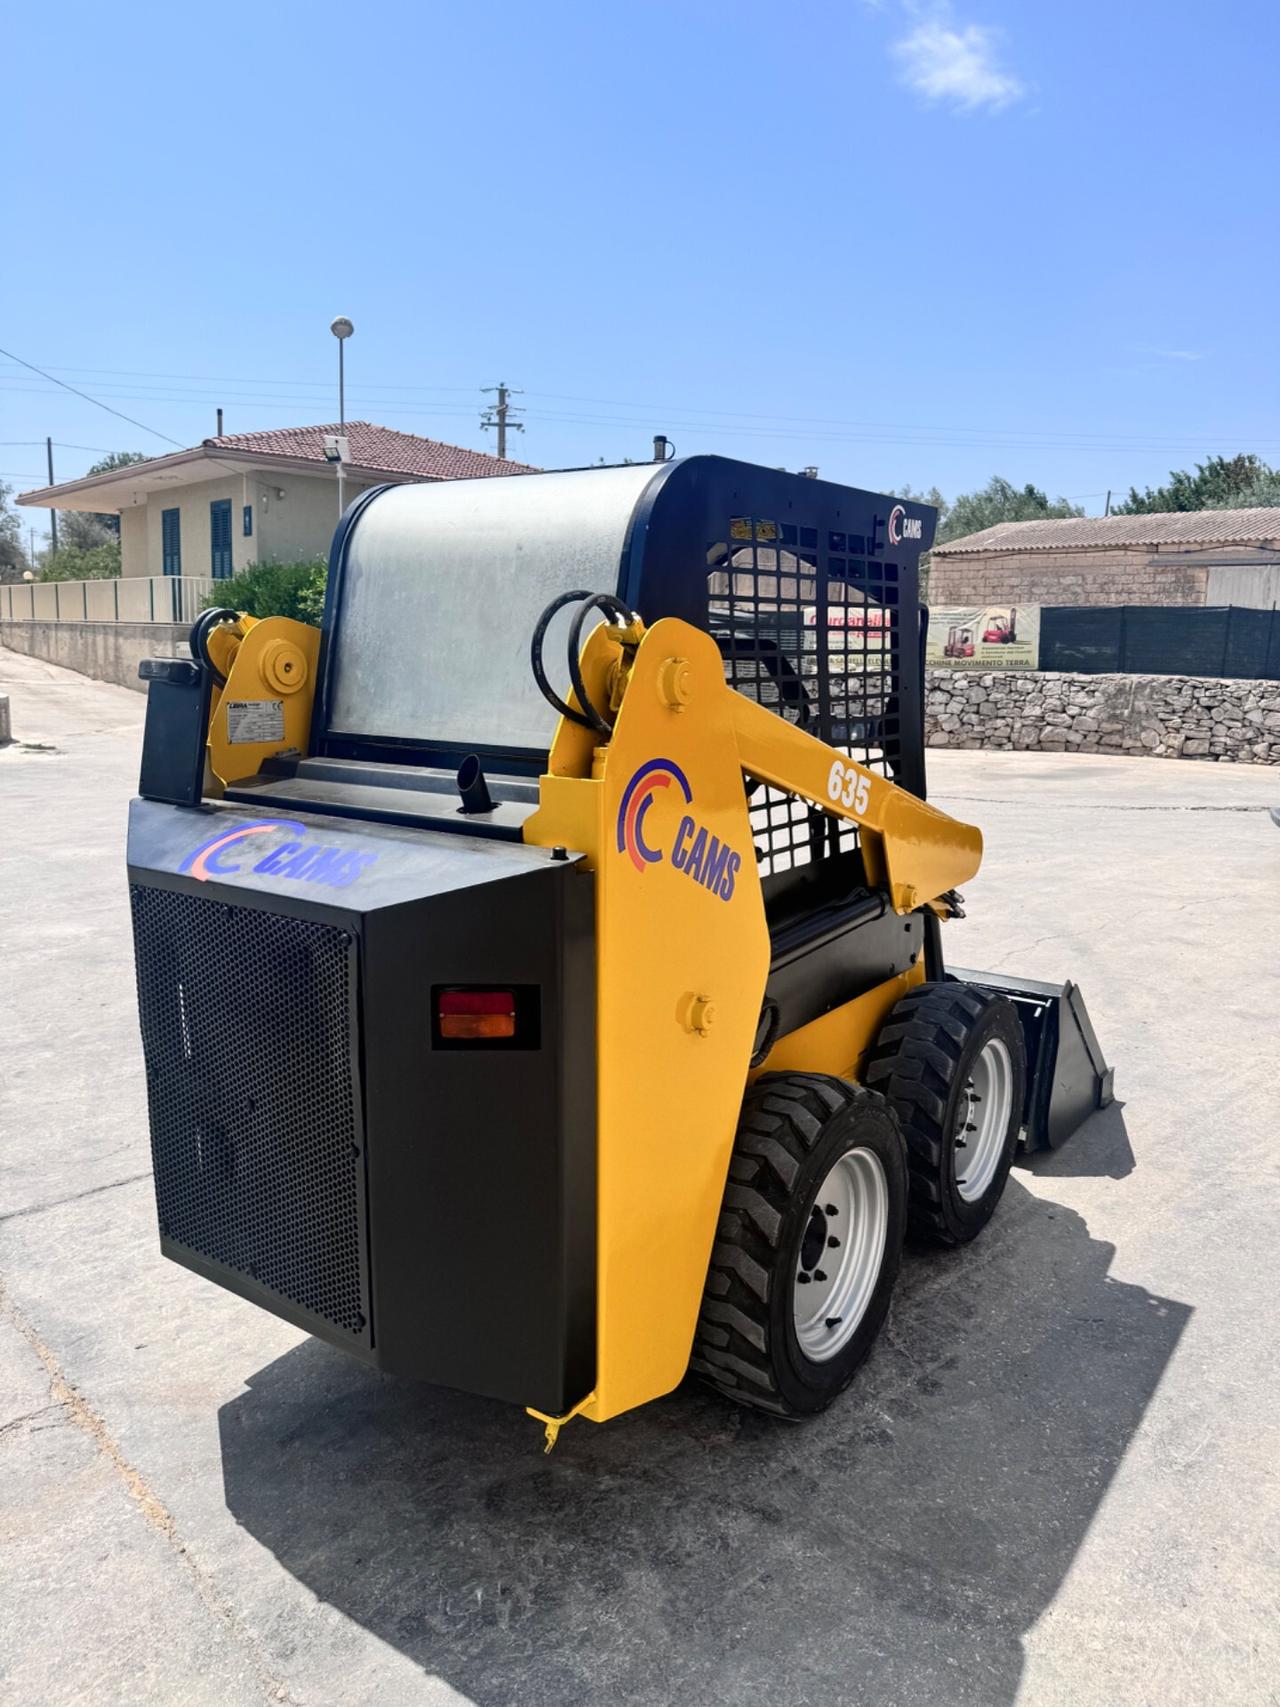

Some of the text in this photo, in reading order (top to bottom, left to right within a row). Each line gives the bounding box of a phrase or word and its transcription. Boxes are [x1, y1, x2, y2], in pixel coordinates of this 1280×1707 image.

[902, 518, 922, 539] CAMS
[955, 659, 1003, 667] MOVIMENTO
[1005, 659, 1031, 667] TERRA
[827, 760, 872, 816] 635
[253, 842, 379, 888] CAMS
[671, 815, 741, 902] CAMS
